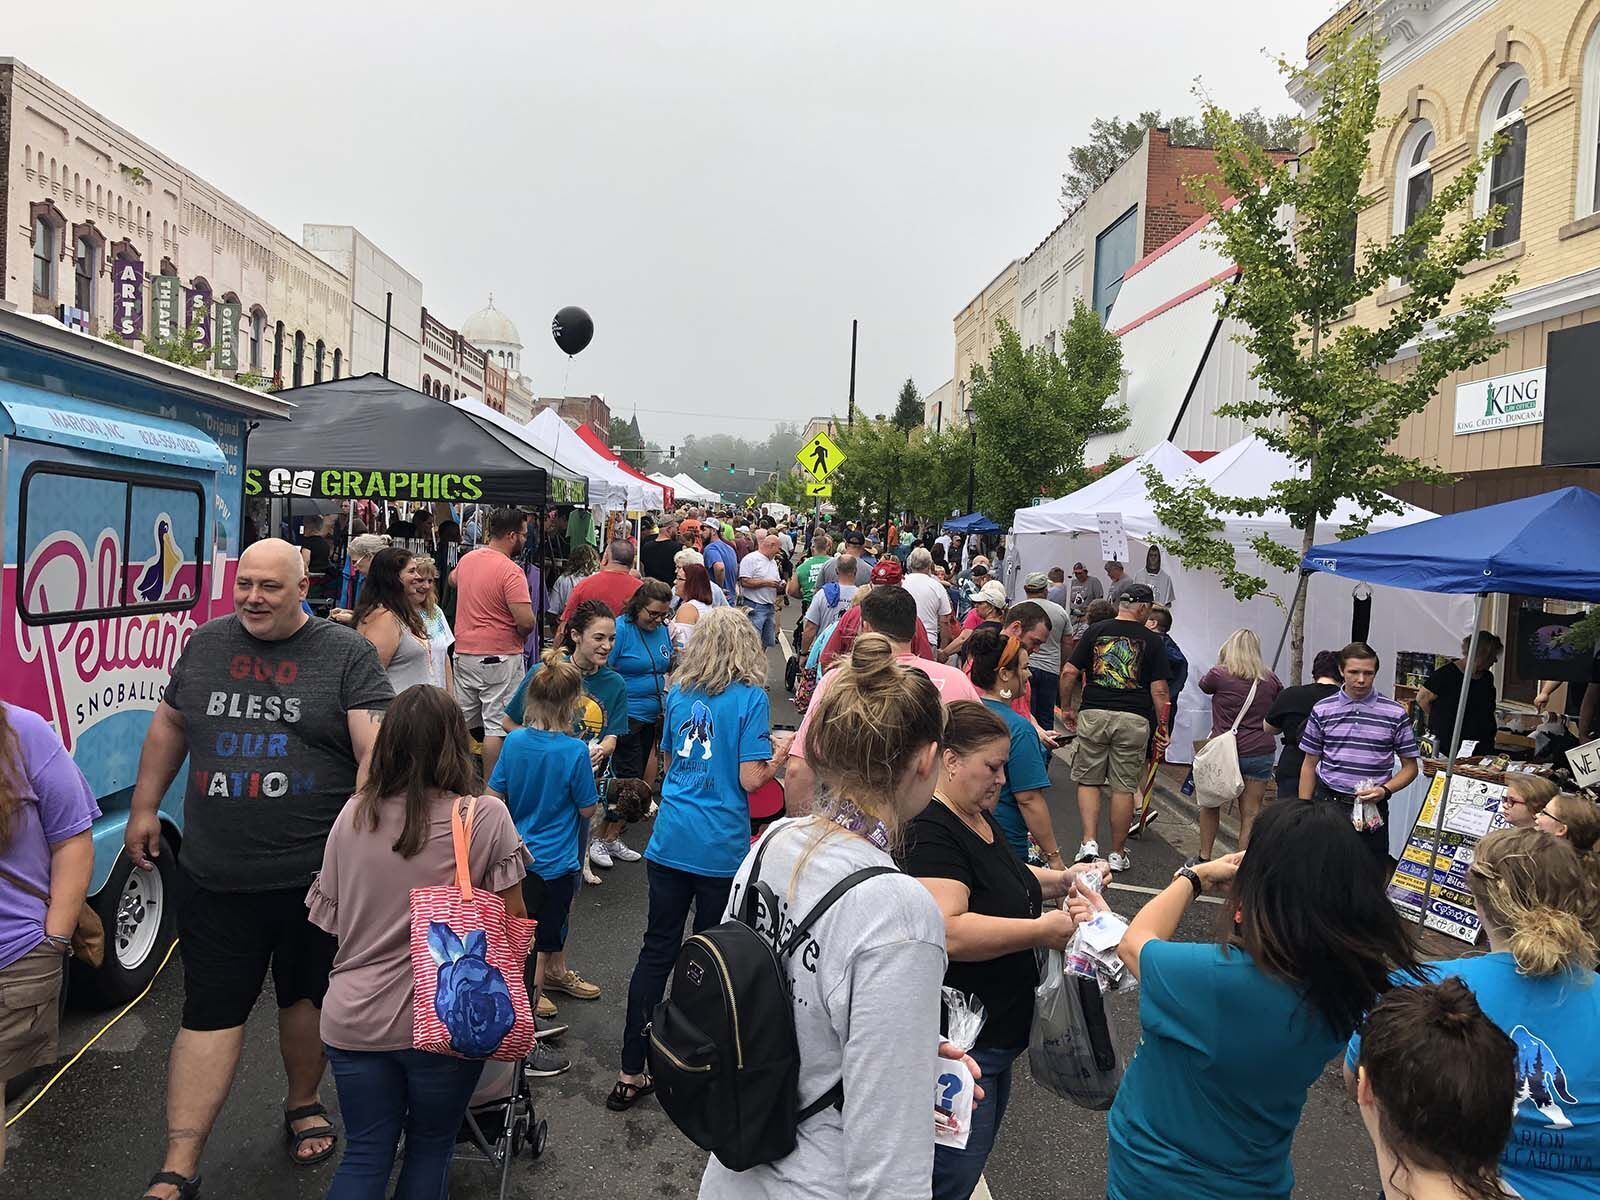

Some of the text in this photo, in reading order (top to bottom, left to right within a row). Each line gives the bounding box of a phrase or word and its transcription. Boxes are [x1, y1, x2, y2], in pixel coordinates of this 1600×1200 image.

[120, 265, 136, 335] ARTS
[222, 308, 232, 366] GALLERY
[1491, 379, 1538, 414] KING
[1505, 412, 1536, 424] DUNCAN
[217, 438, 238, 456] leans
[320, 470, 484, 500] GRAPHICS
[229, 656, 297, 685] GOD
[76, 681, 165, 724] SNOBALLS
[206, 691, 302, 723] BLESS
[214, 732, 289, 758] OUR
[1571, 753, 1597, 776] WE
[1511, 1129, 1565, 1149] ARION
